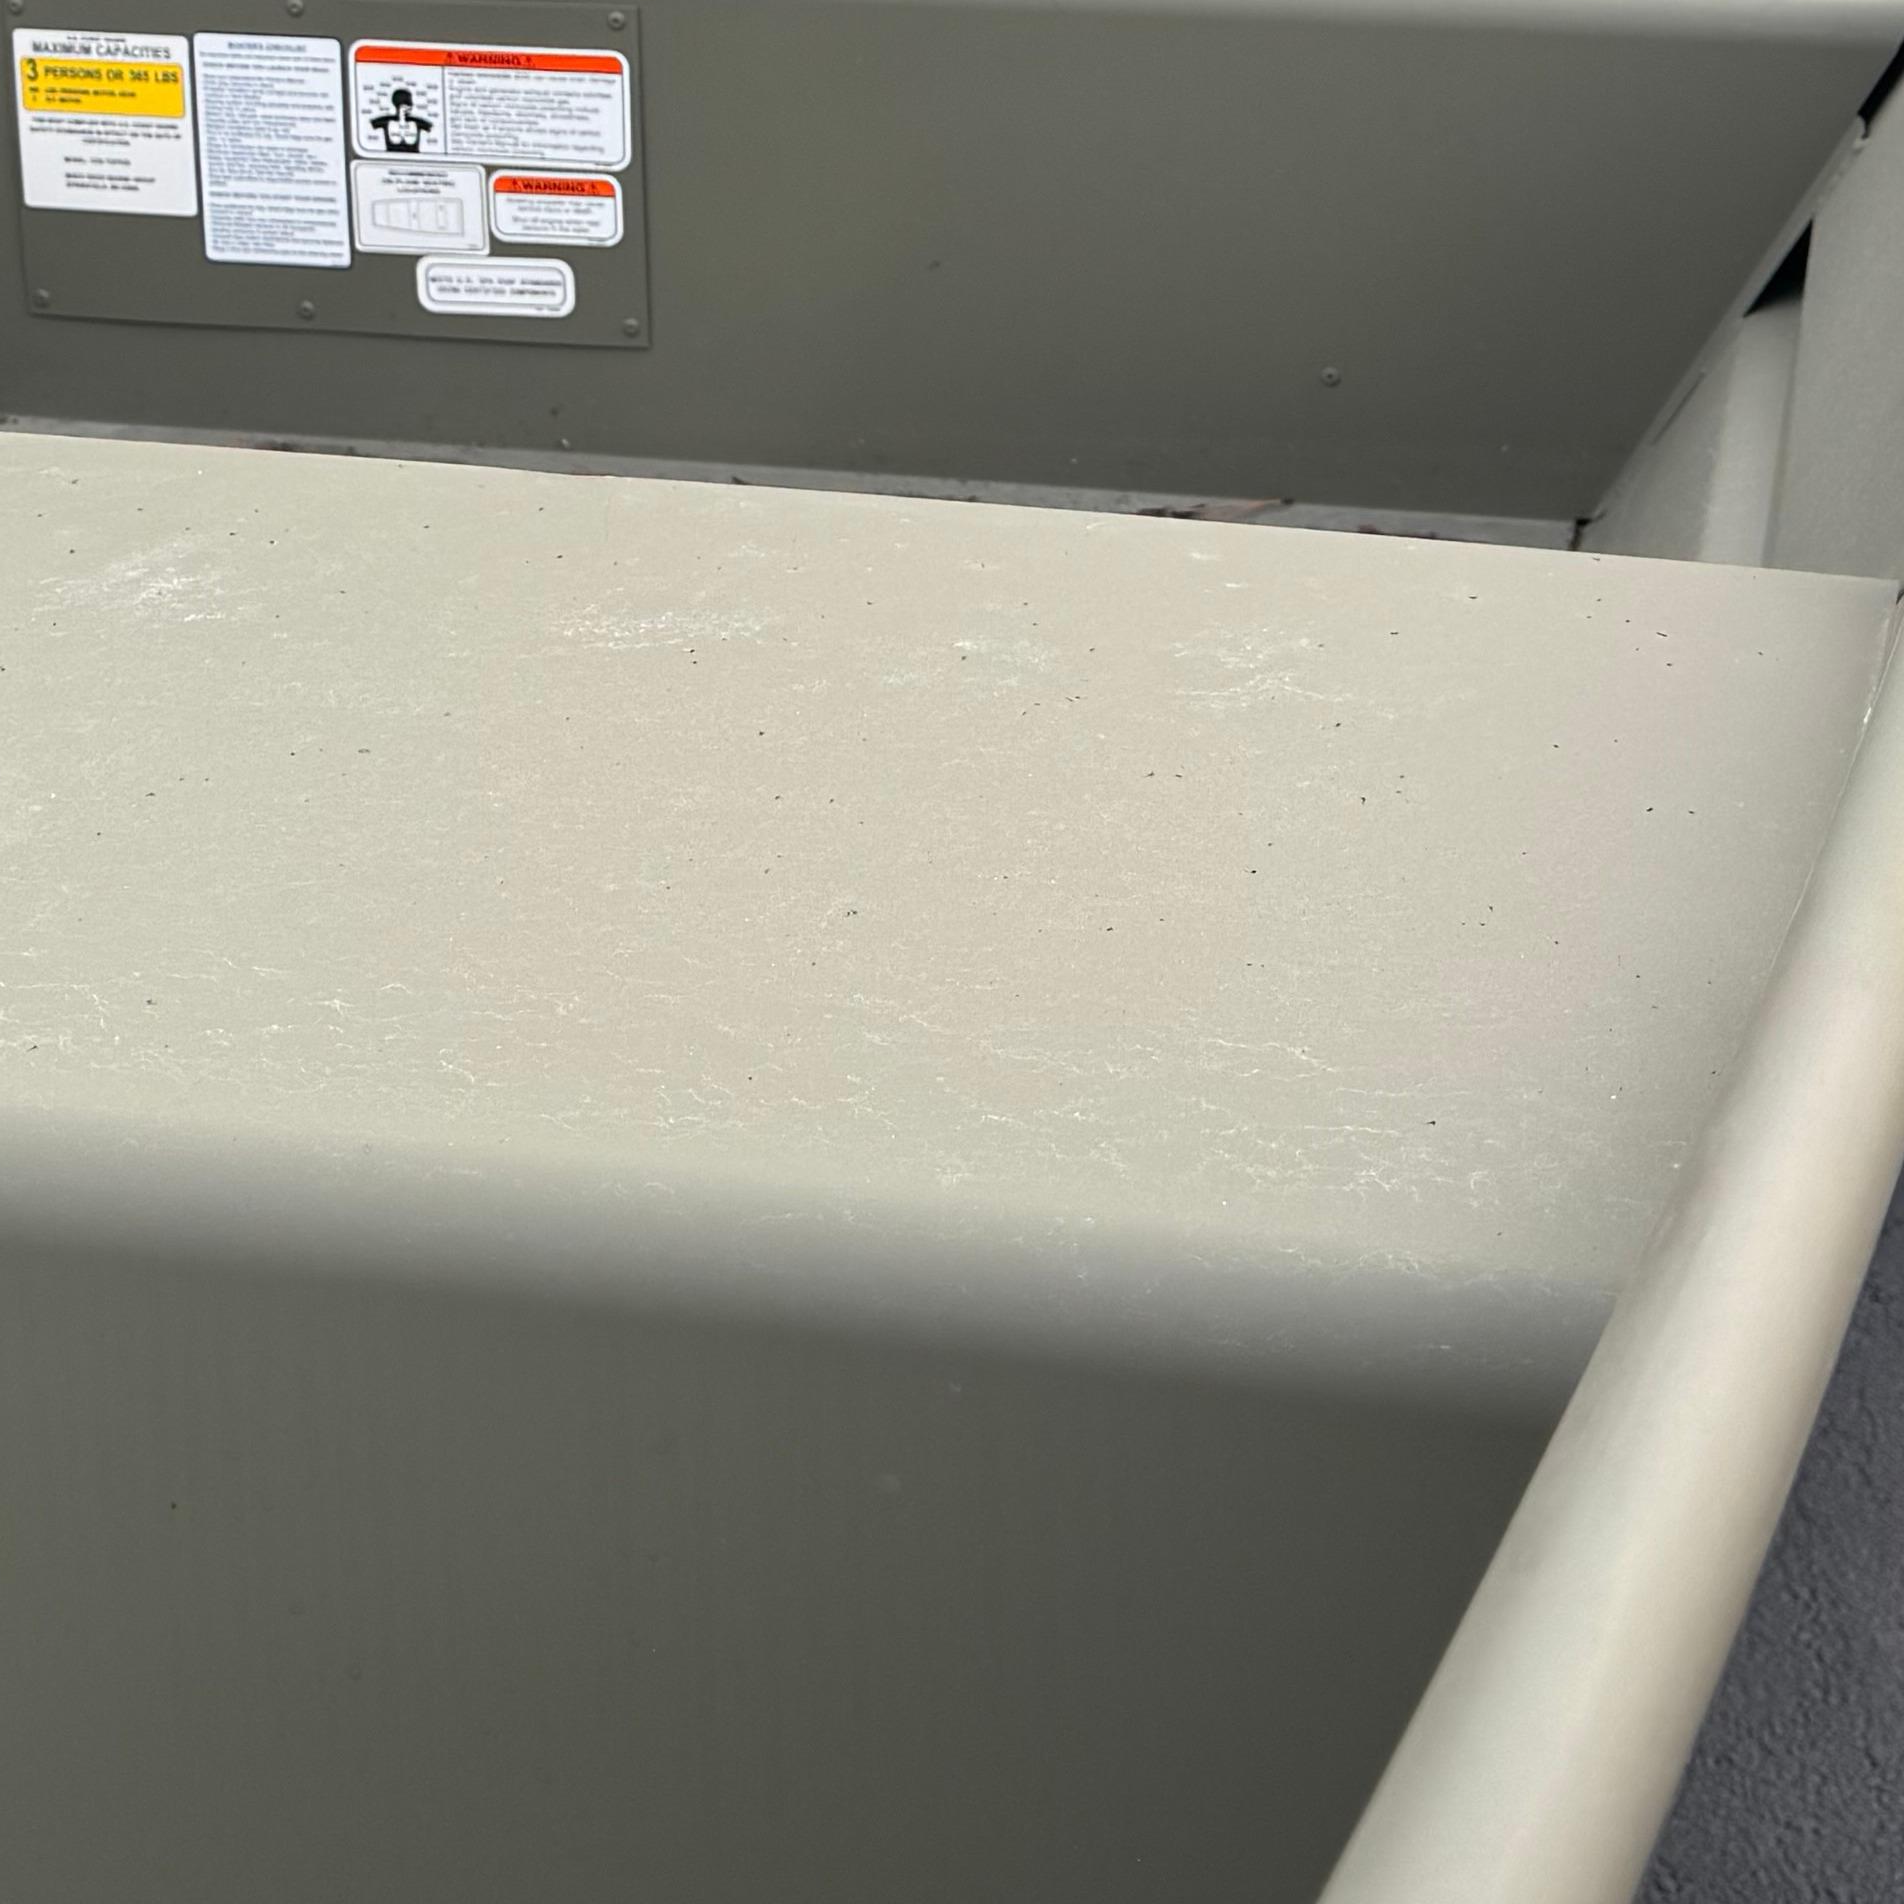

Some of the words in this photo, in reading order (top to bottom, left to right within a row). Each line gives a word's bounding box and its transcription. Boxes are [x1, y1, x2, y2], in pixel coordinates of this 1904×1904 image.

[32, 40, 91, 56] MAXIMUM
[96, 45, 171, 59] CAPACITIES
[457, 53, 522, 67] WARNING
[26, 58, 39, 81] 3
[44, 65, 102, 81] PERSONS
[106, 67, 124, 82] OR
[154, 70, 179, 84] LBS
[522, 180, 586, 193] WARNING
